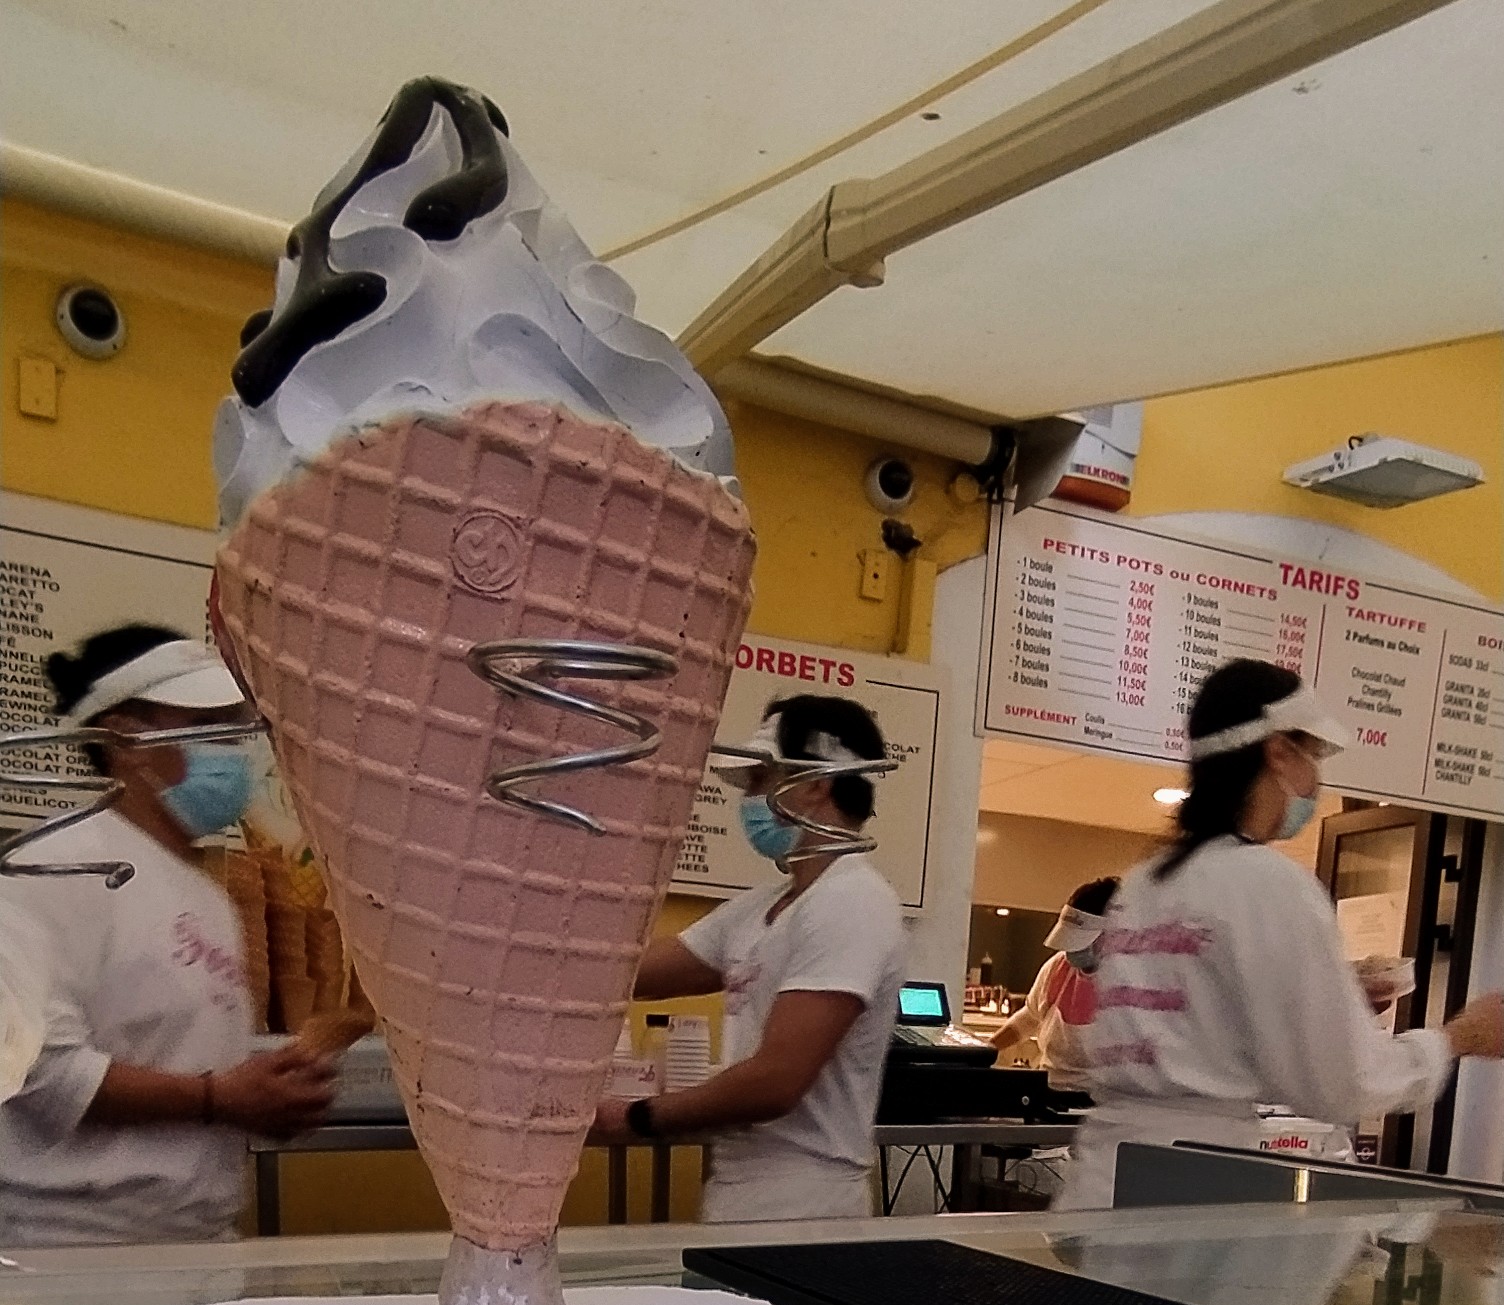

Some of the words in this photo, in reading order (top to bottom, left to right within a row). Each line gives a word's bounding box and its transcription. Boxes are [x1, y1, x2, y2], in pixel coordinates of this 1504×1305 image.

[1023, 556, 1028, 567] 1
[1029, 557, 1054, 573] boule
[1130, 580, 1155, 596] 2,50€
[1043, 538, 1110, 564] PETITS
[1117, 554, 1164, 576] POTS
[1169, 570, 1190, 582] ou
[1196, 573, 1278, 601] CORNETS
[1279, 563, 1361, 601] TARIFS
[1019, 589, 1025, 601] 3
[1026, 591, 1055, 608] boules
[1126, 612, 1152, 628] 5,50€
[1020, 573, 1027, 585] 2
[1028, 574, 1057, 591] boules
[1128, 597, 1153, 612] 4,00€
[1018, 606, 1024, 617] 4
[1025, 607, 1054, 624] boules
[1125, 628, 1150, 644] 7,00€
[1184, 625, 1193, 637] 11
[1185, 609, 1195, 621] 10
[1346, 606, 1427, 634] TARTUFFE
[1015, 639, 1021, 650] 6
[1023, 640, 1051, 656] boules
[1119, 660, 1148, 675] 10,00€
[1017, 622, 1023, 634] 5
[1024, 624, 1053, 640] boules
[1124, 644, 1149, 660] 8,50€
[1182, 641, 1191, 652] 12
[1345, 630, 1352, 641] 2
[1353, 631, 1385, 649] Parfums
[1387, 640, 1397, 650] au
[1398, 641, 1421, 656] Choix
[1014, 655, 1020, 666] 7
[1021, 656, 1050, 672] boules
[1117, 676, 1147, 691] 11,50€
[1181, 656, 1190, 668] 13
[1351, 667, 1383, 684] Chocolat
[1383, 672, 1407, 688] Chaud
[1013, 671, 1019, 683] 8
[1020, 672, 1049, 689] boules
[1116, 691, 1146, 707] 13,00€
[1177, 687, 1187, 699] 15
[1005, 704, 1078, 726] SUPPLÉMENT
[1357, 727, 1388, 747] 7,00€
